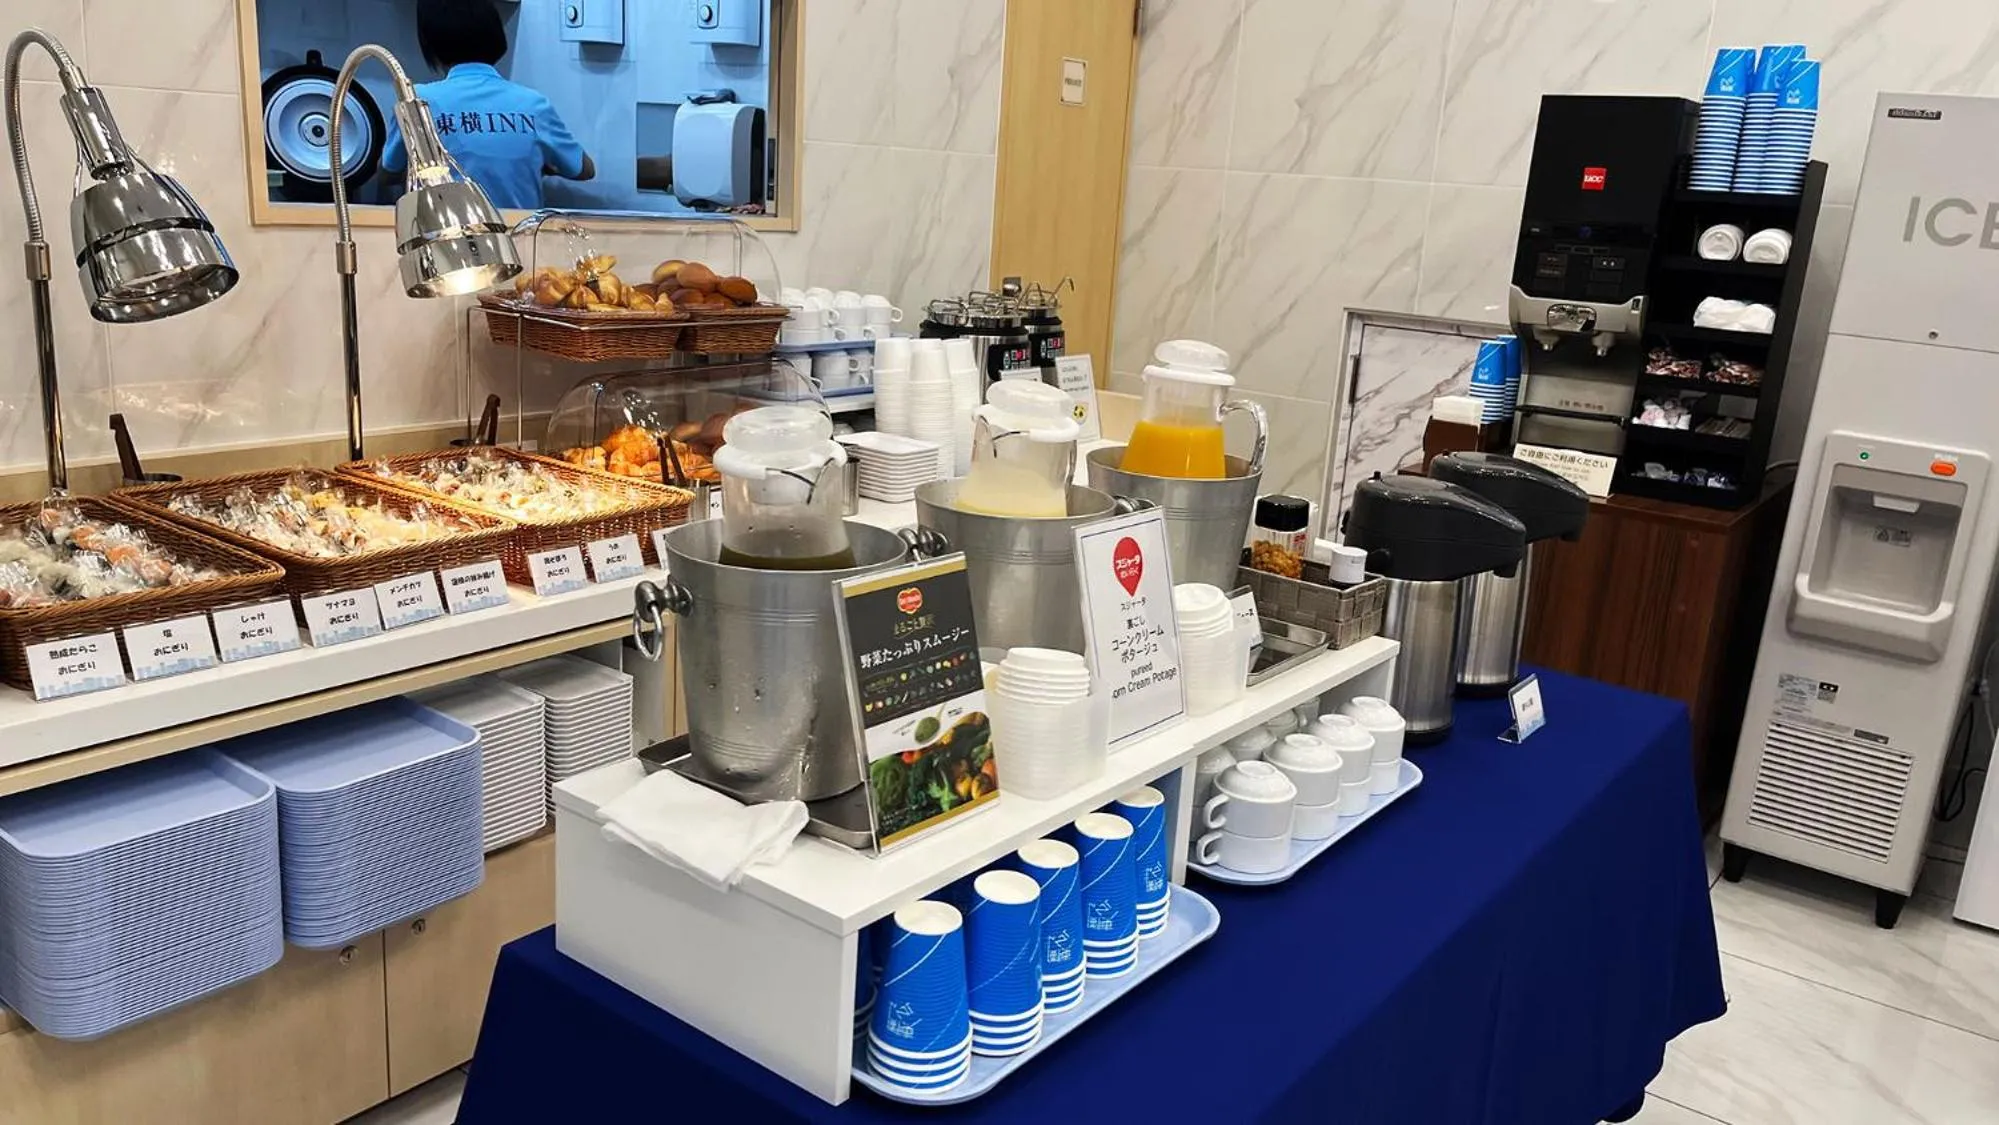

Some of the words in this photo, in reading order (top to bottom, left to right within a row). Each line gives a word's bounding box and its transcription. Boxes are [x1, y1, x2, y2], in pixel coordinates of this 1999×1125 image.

[436, 111, 537, 136] 東横INN
[1902, 196, 1999, 250] ICE
[390, 580, 422, 595] メンチカツ
[326, 598, 356, 610] ツナマヨ
[397, 595, 423, 608] おにぎり
[1120, 596, 1146, 611] スジャータ
[240, 612, 265, 623] しゃけ
[329, 612, 359, 625] おにぎり
[240, 626, 273, 640] おにぎり
[1111, 624, 1165, 651] コーンクリーム
[154, 642, 189, 656] おにぎり
[860, 626, 970, 669] 野菜たっぷりスムージー
[1121, 642, 1158, 663] ポタージュ
[58, 661, 96, 676] おにぎり
[1112, 686, 1127, 699] orn
[1127, 677, 1151, 693] Cream
[1152, 667, 1177, 682] Potage
